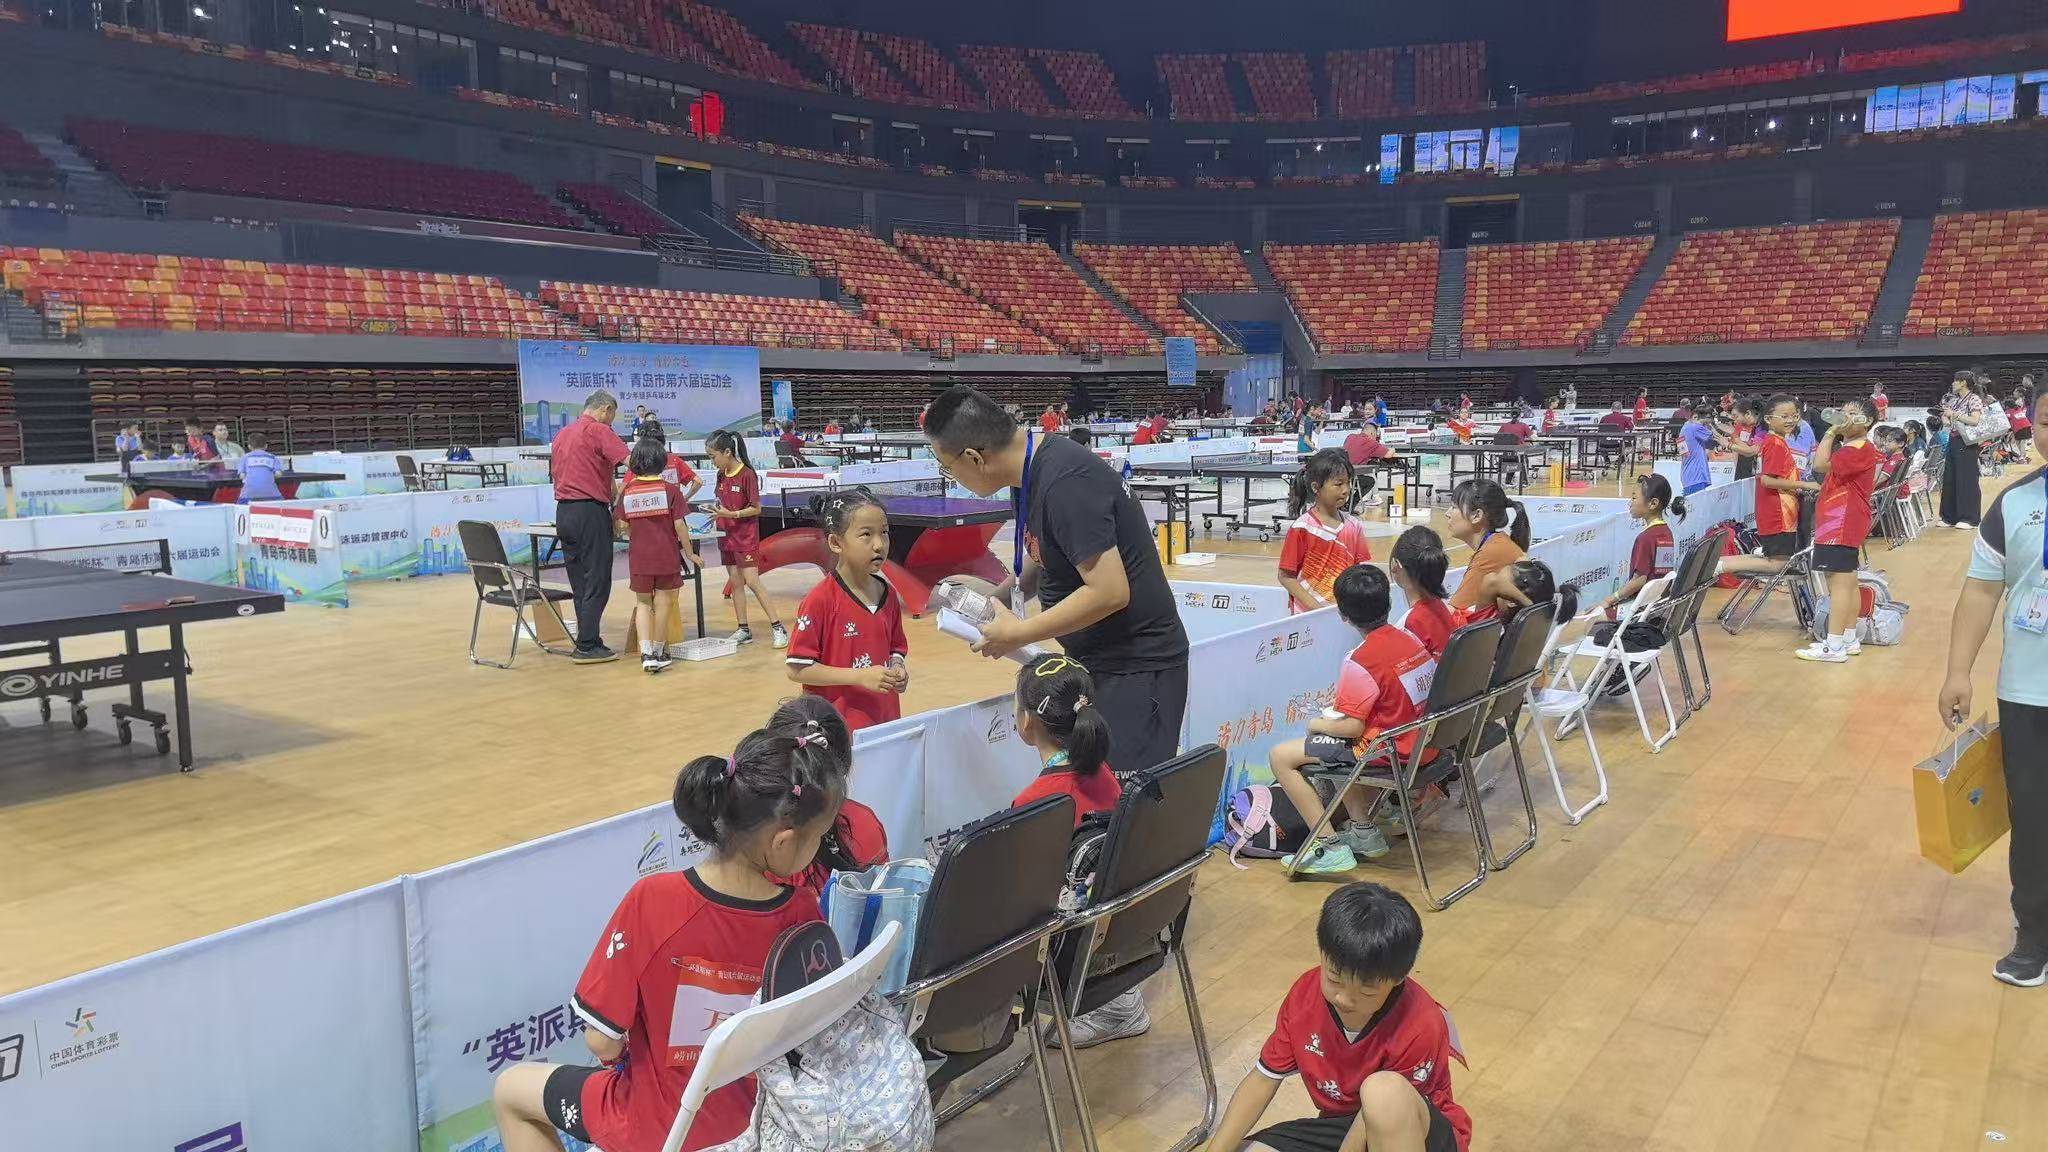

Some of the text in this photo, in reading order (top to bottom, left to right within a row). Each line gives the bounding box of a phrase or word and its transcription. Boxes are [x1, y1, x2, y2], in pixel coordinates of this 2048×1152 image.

[559, 372, 732, 389] “英派斯杯” 青岛市第六届运动会
[238, 514, 246, 536] 0
[319, 515, 329, 540] 0
[39, 663, 125, 689] YINHE
[49, 1031, 119, 1062] 中国体育彩票
[51, 1042, 120, 1070] CHINA SPORTS LOTTERY
[673, 1050, 702, 1062] 崂山
